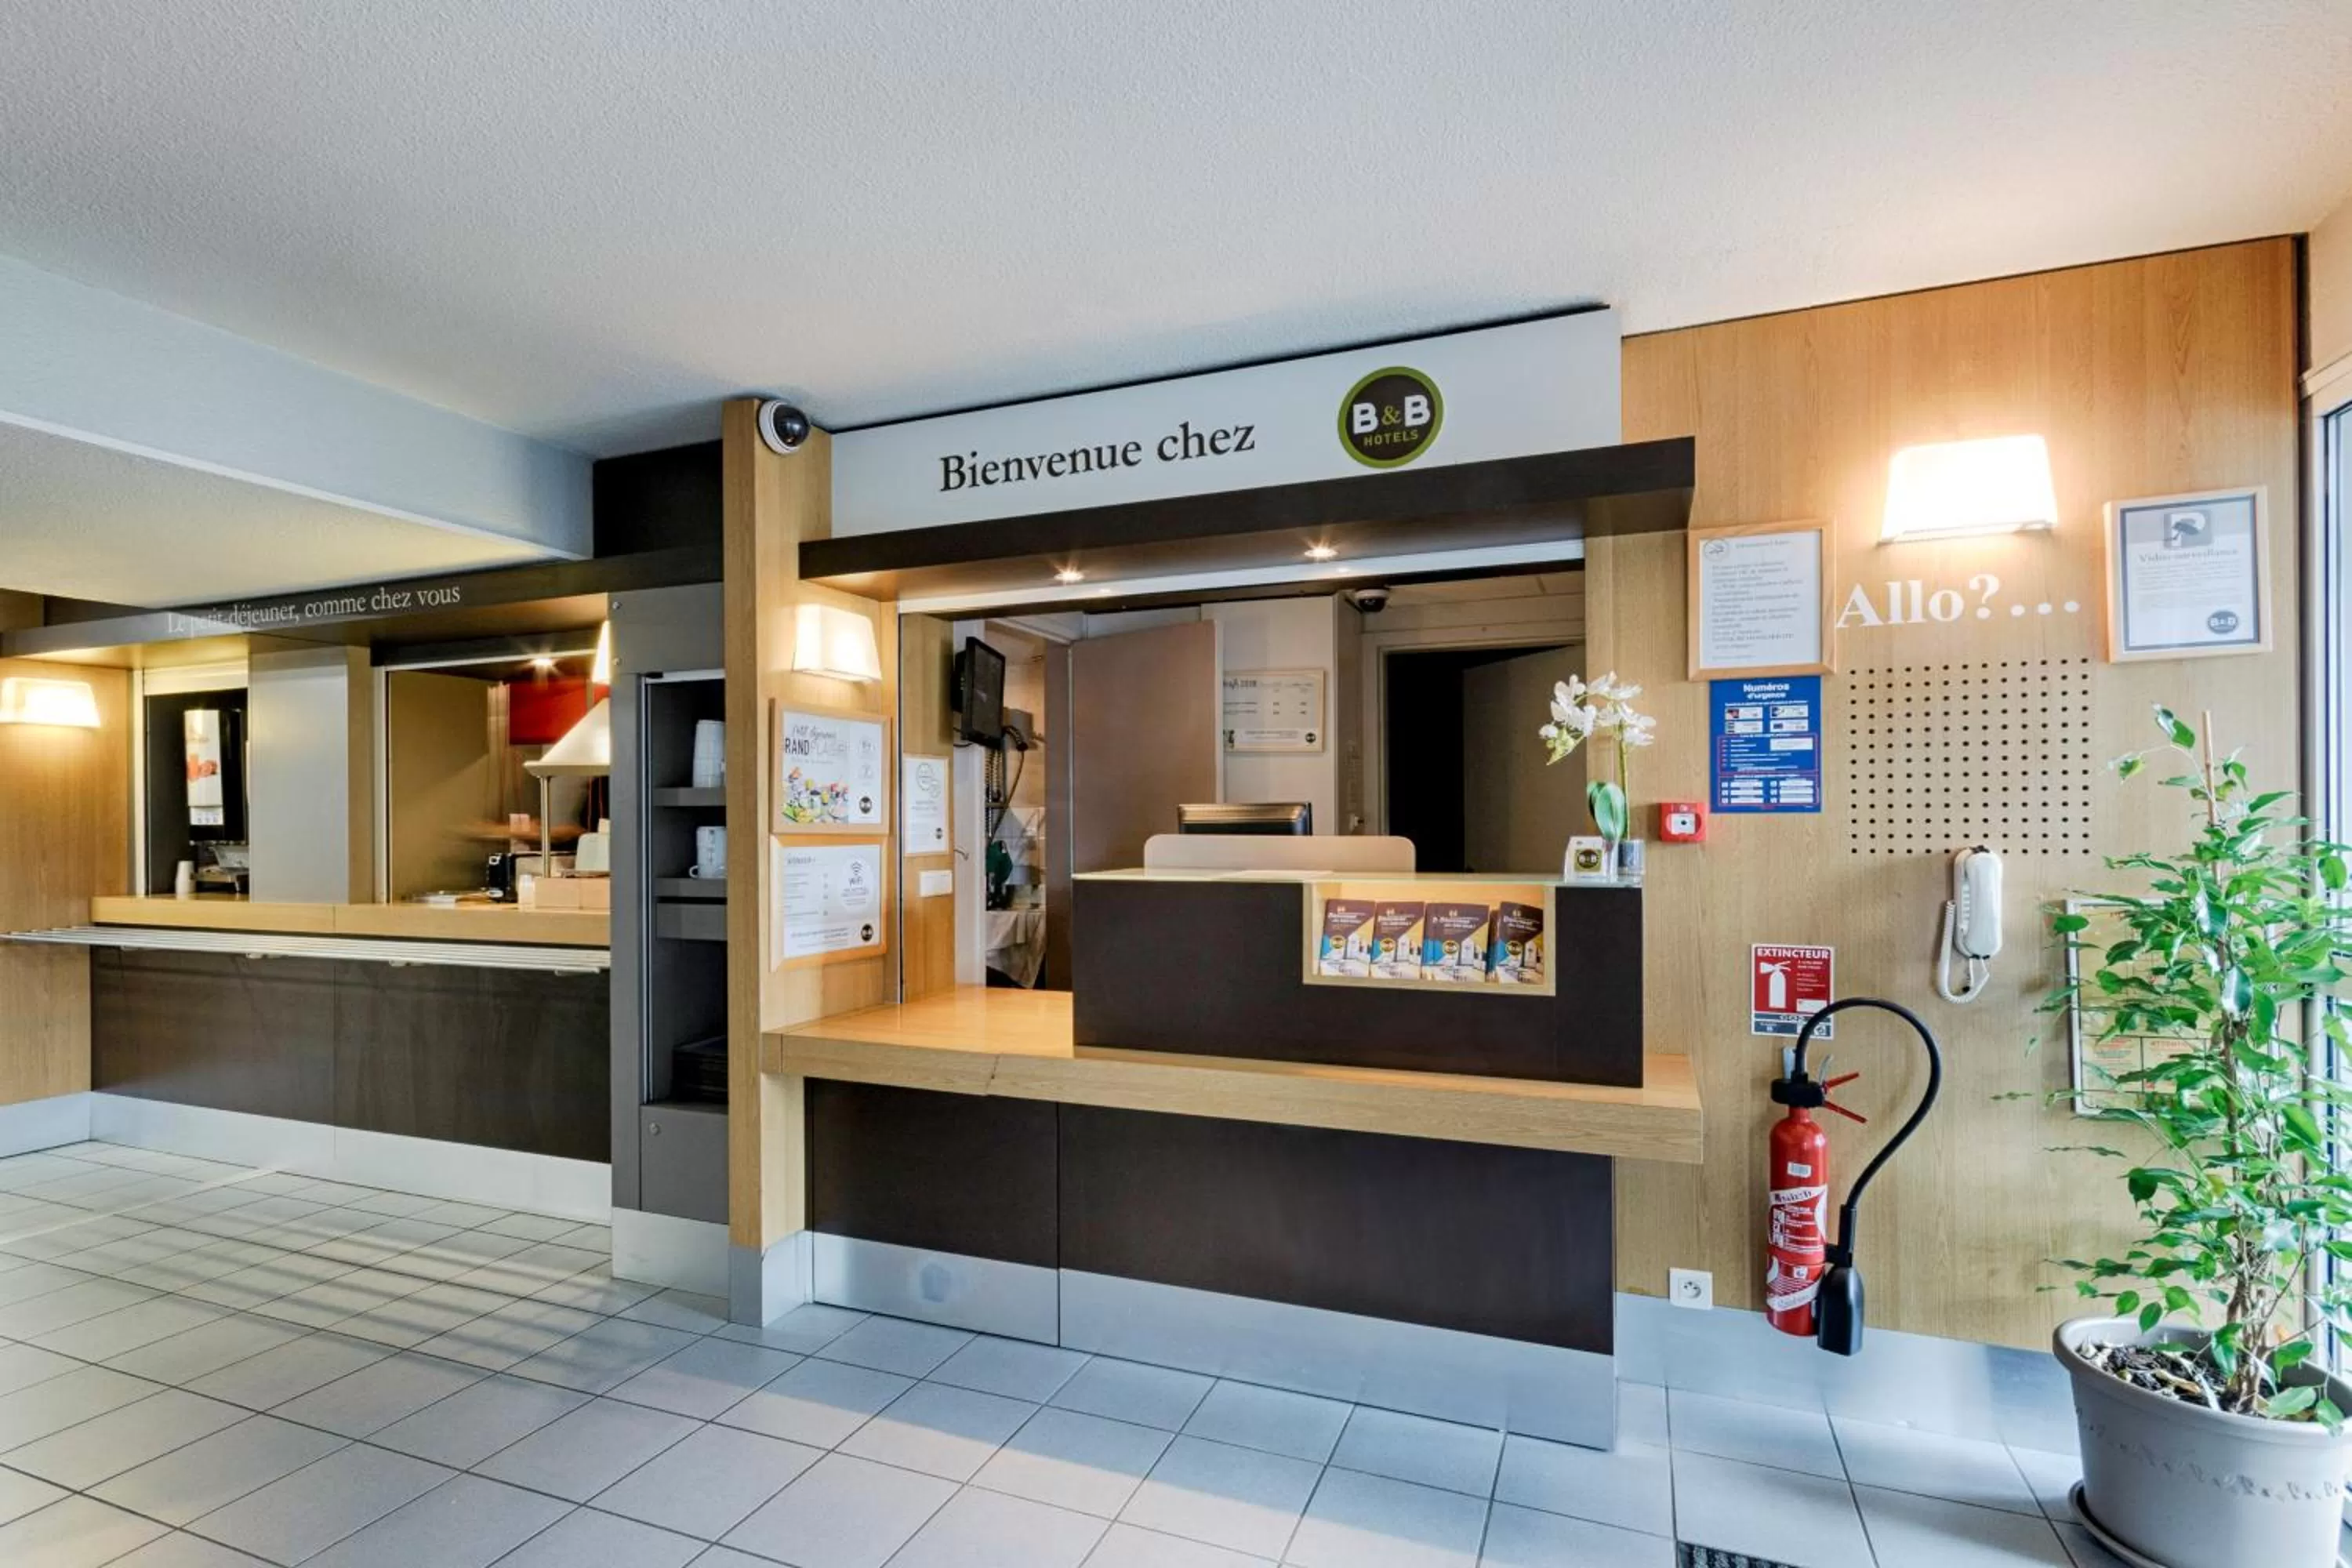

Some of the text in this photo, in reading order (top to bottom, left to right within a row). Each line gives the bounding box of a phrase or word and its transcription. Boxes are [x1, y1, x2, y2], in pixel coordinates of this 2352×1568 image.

[1352, 394, 1431, 434] B&B
[1363, 429, 1419, 446] HOTELS
[939, 420, 1255, 492] Bienvenue chez
[168, 613, 185, 633] Le
[304, 597, 366, 618] comme
[371, 586, 412, 611] chez
[416, 586, 461, 606] vous
[1743, 681, 1790, 693] Numéros
[1756, 947, 1829, 960] EXTINCTEUR
